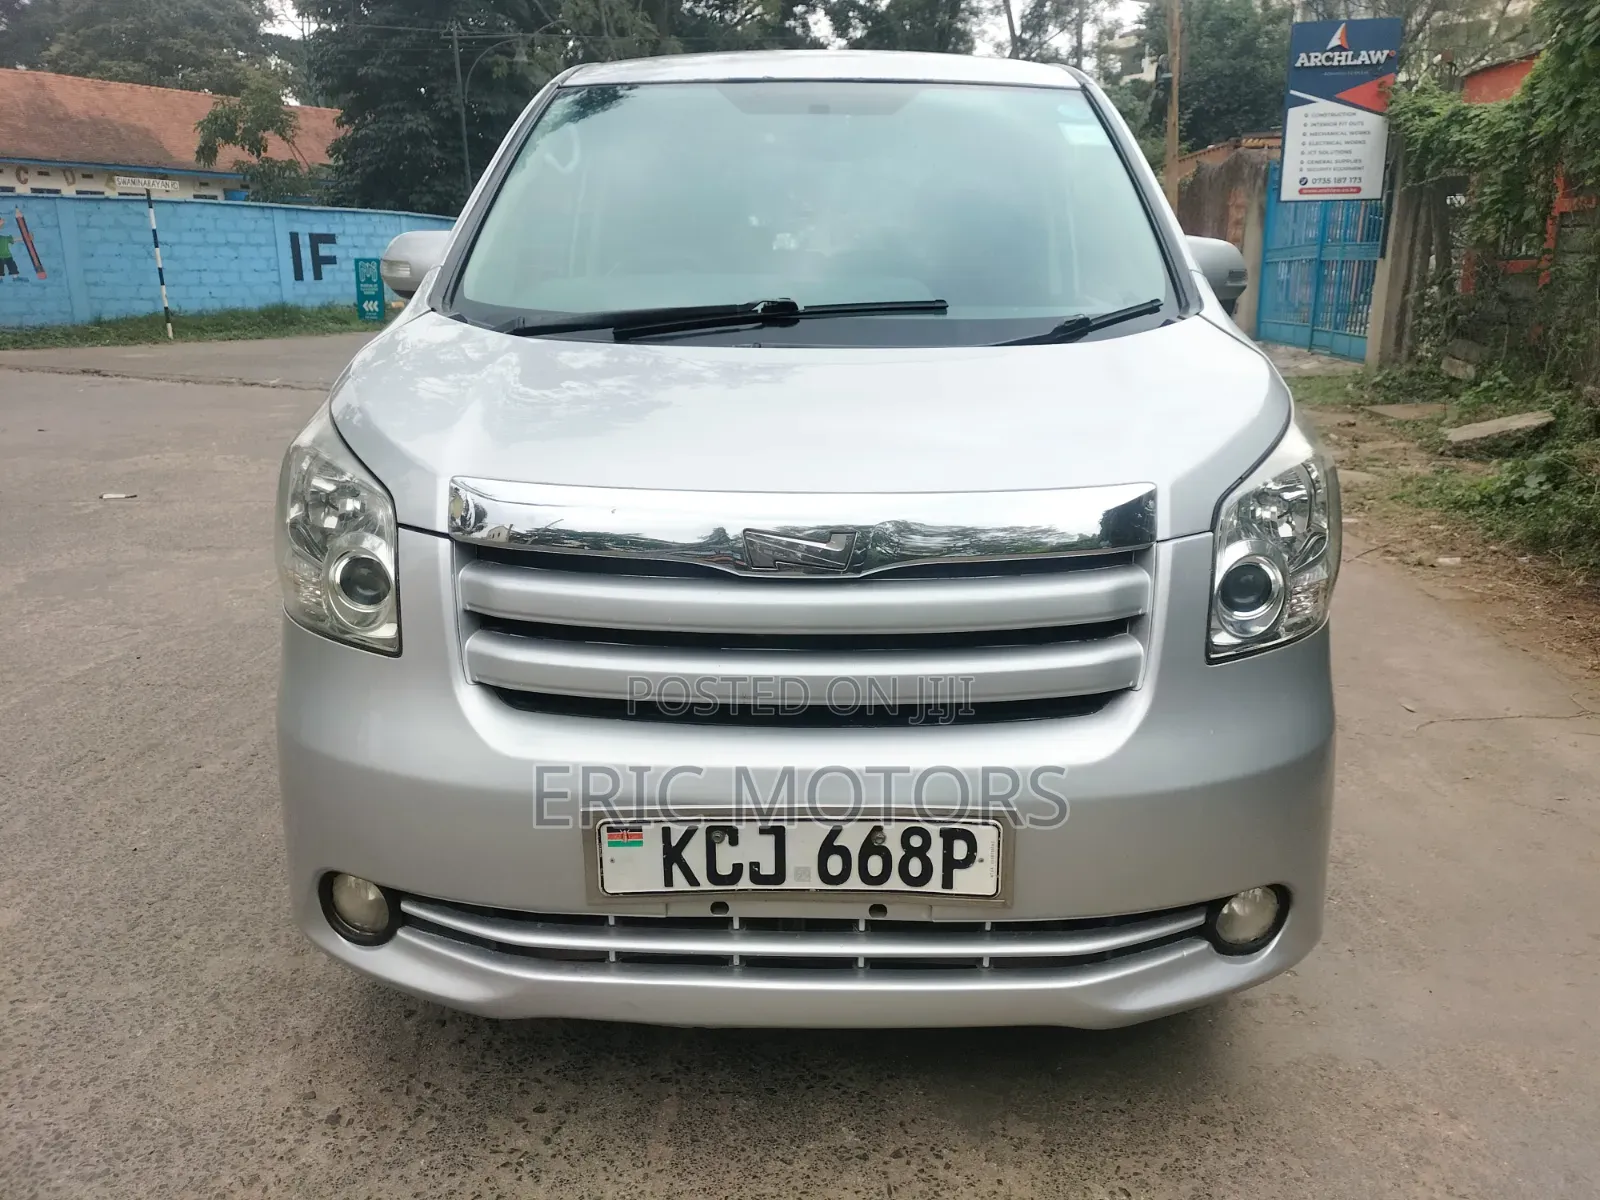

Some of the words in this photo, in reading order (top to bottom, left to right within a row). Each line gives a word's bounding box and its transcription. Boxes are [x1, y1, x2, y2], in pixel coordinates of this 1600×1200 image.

[1294, 49, 1390, 67] ARCHLAW
[289, 231, 337, 281] IF
[662, 825, 787, 888] KCJ
[817, 825, 979, 889] 668P
